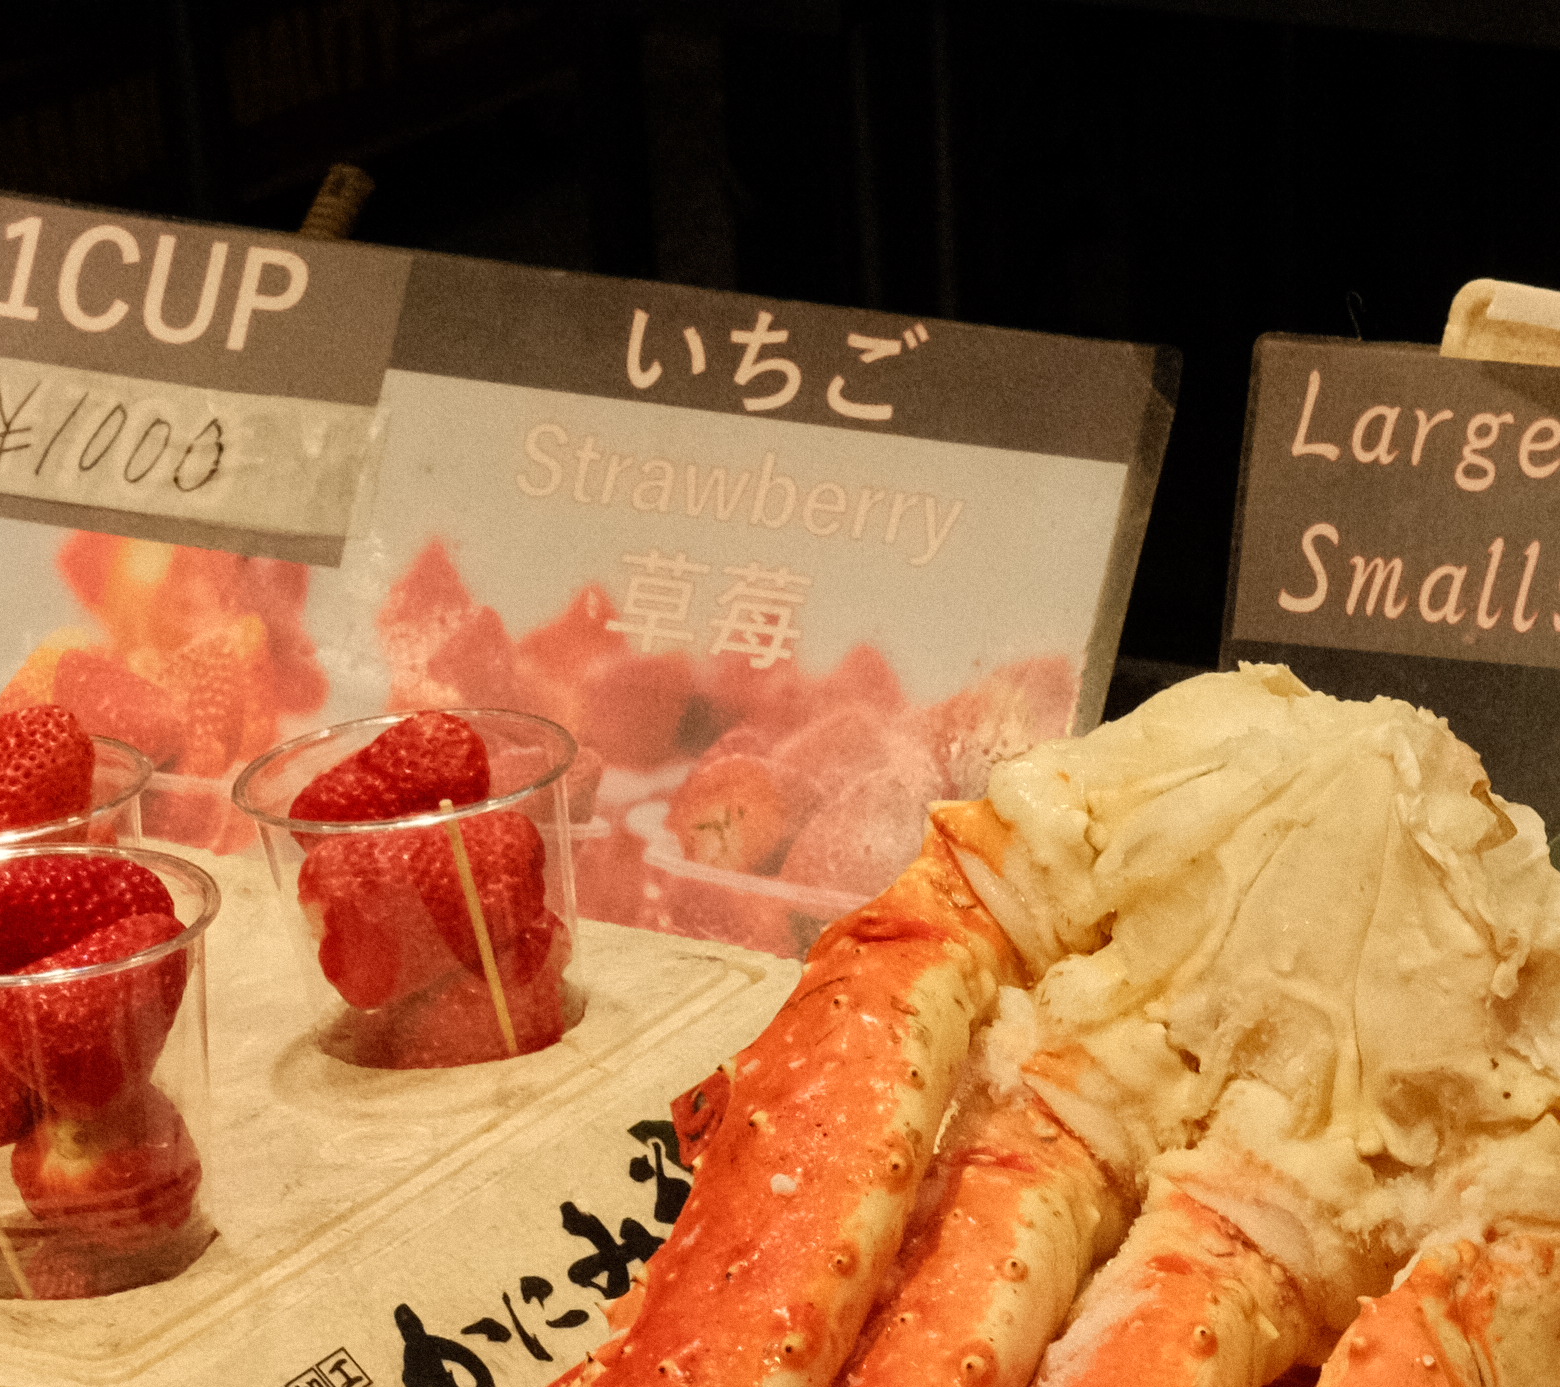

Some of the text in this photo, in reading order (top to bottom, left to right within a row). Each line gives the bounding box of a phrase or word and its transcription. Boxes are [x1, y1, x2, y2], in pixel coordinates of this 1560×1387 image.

[626, 308, 930, 422] いちご
[515, 423, 966, 568] Strawberry
[605, 550, 814, 671] 草莓
